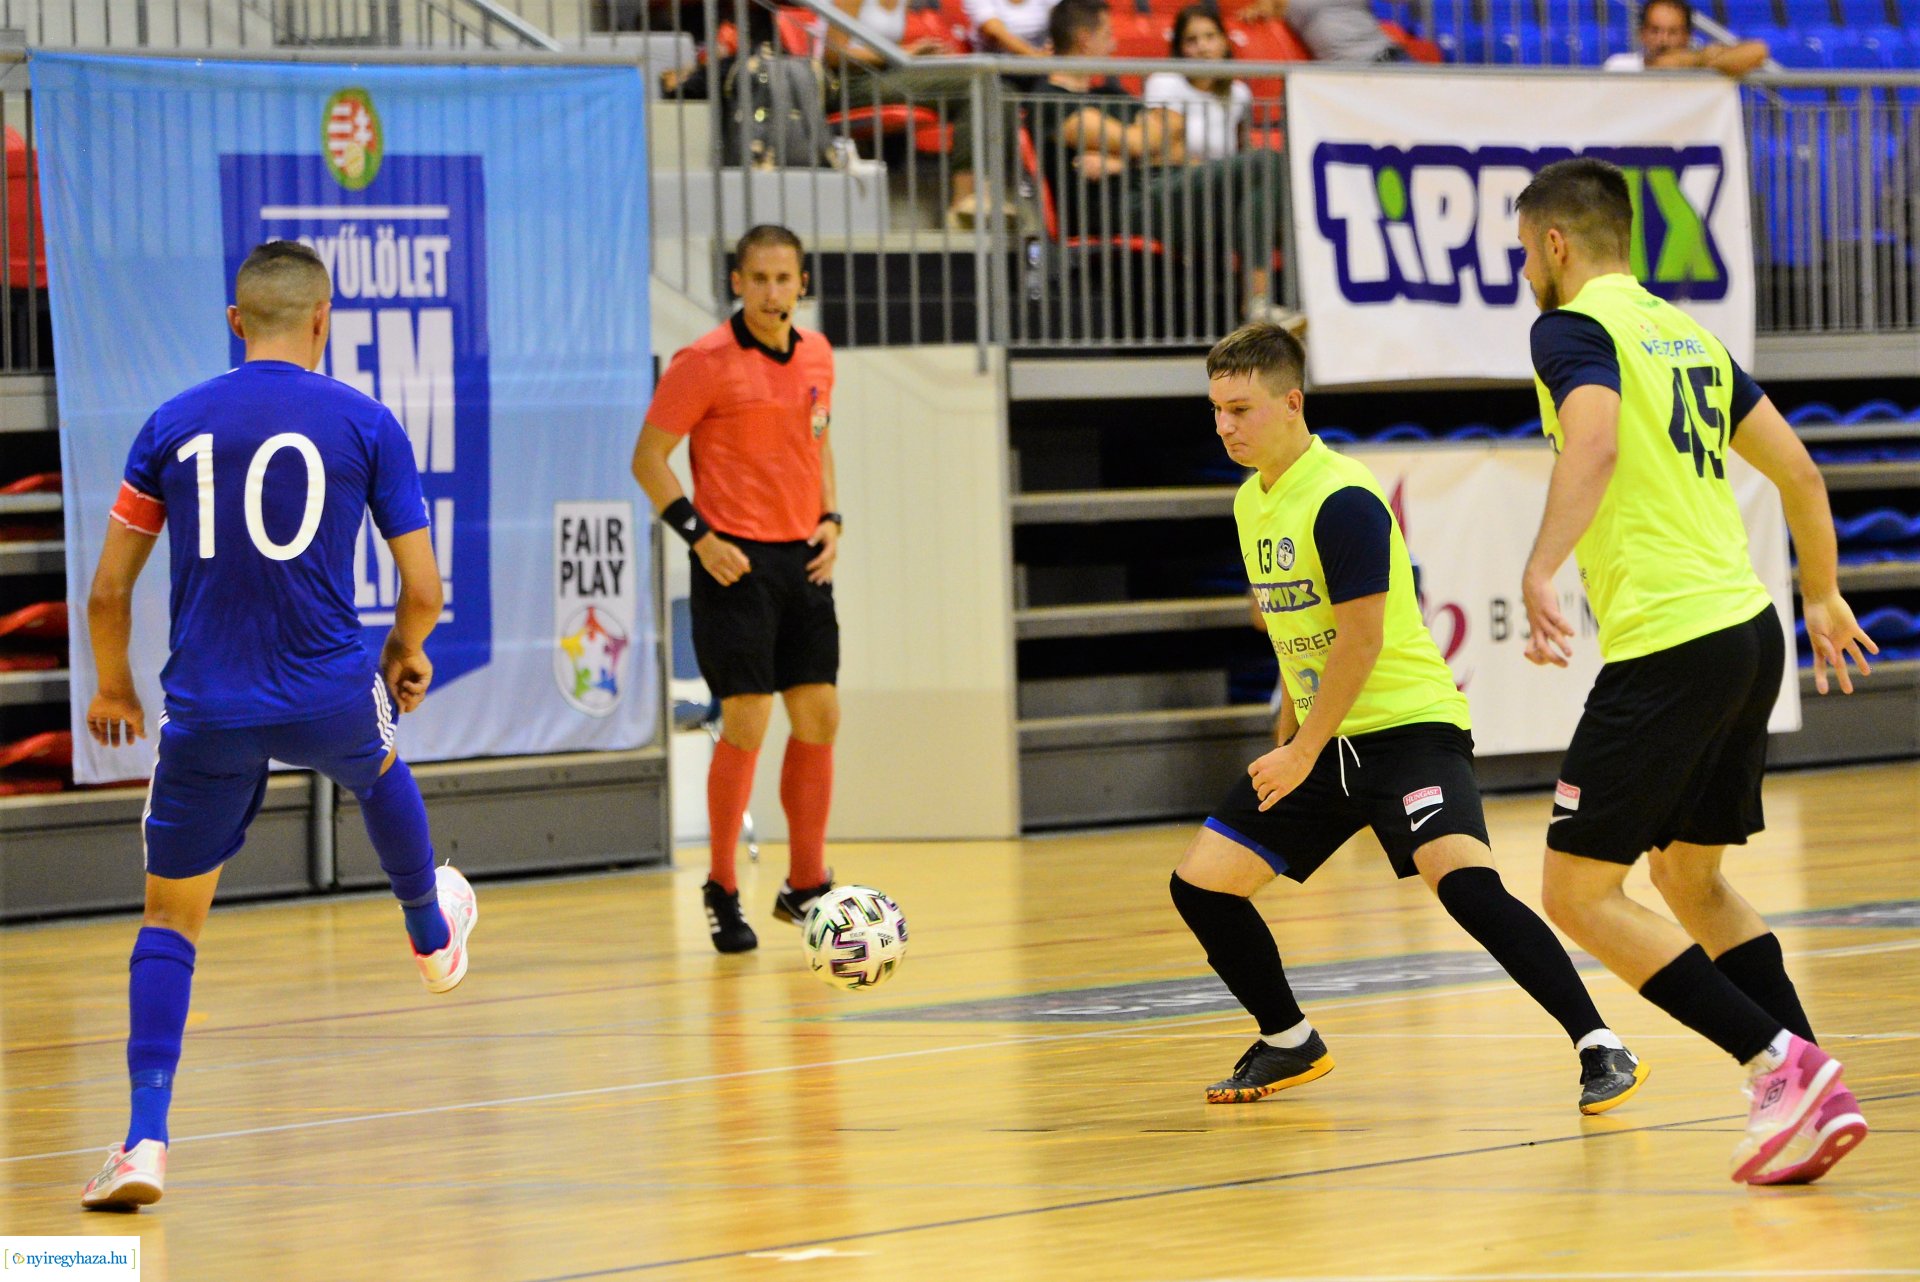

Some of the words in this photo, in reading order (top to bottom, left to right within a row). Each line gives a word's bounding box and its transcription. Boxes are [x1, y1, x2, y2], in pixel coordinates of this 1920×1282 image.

[321, 307, 455, 473] EM
[1668, 366, 1724, 479] 45
[177, 432, 326, 561] 10
[561, 517, 624, 553] FAIR
[1257, 538, 1273, 575] 13
[561, 559, 624, 596] PLAY
